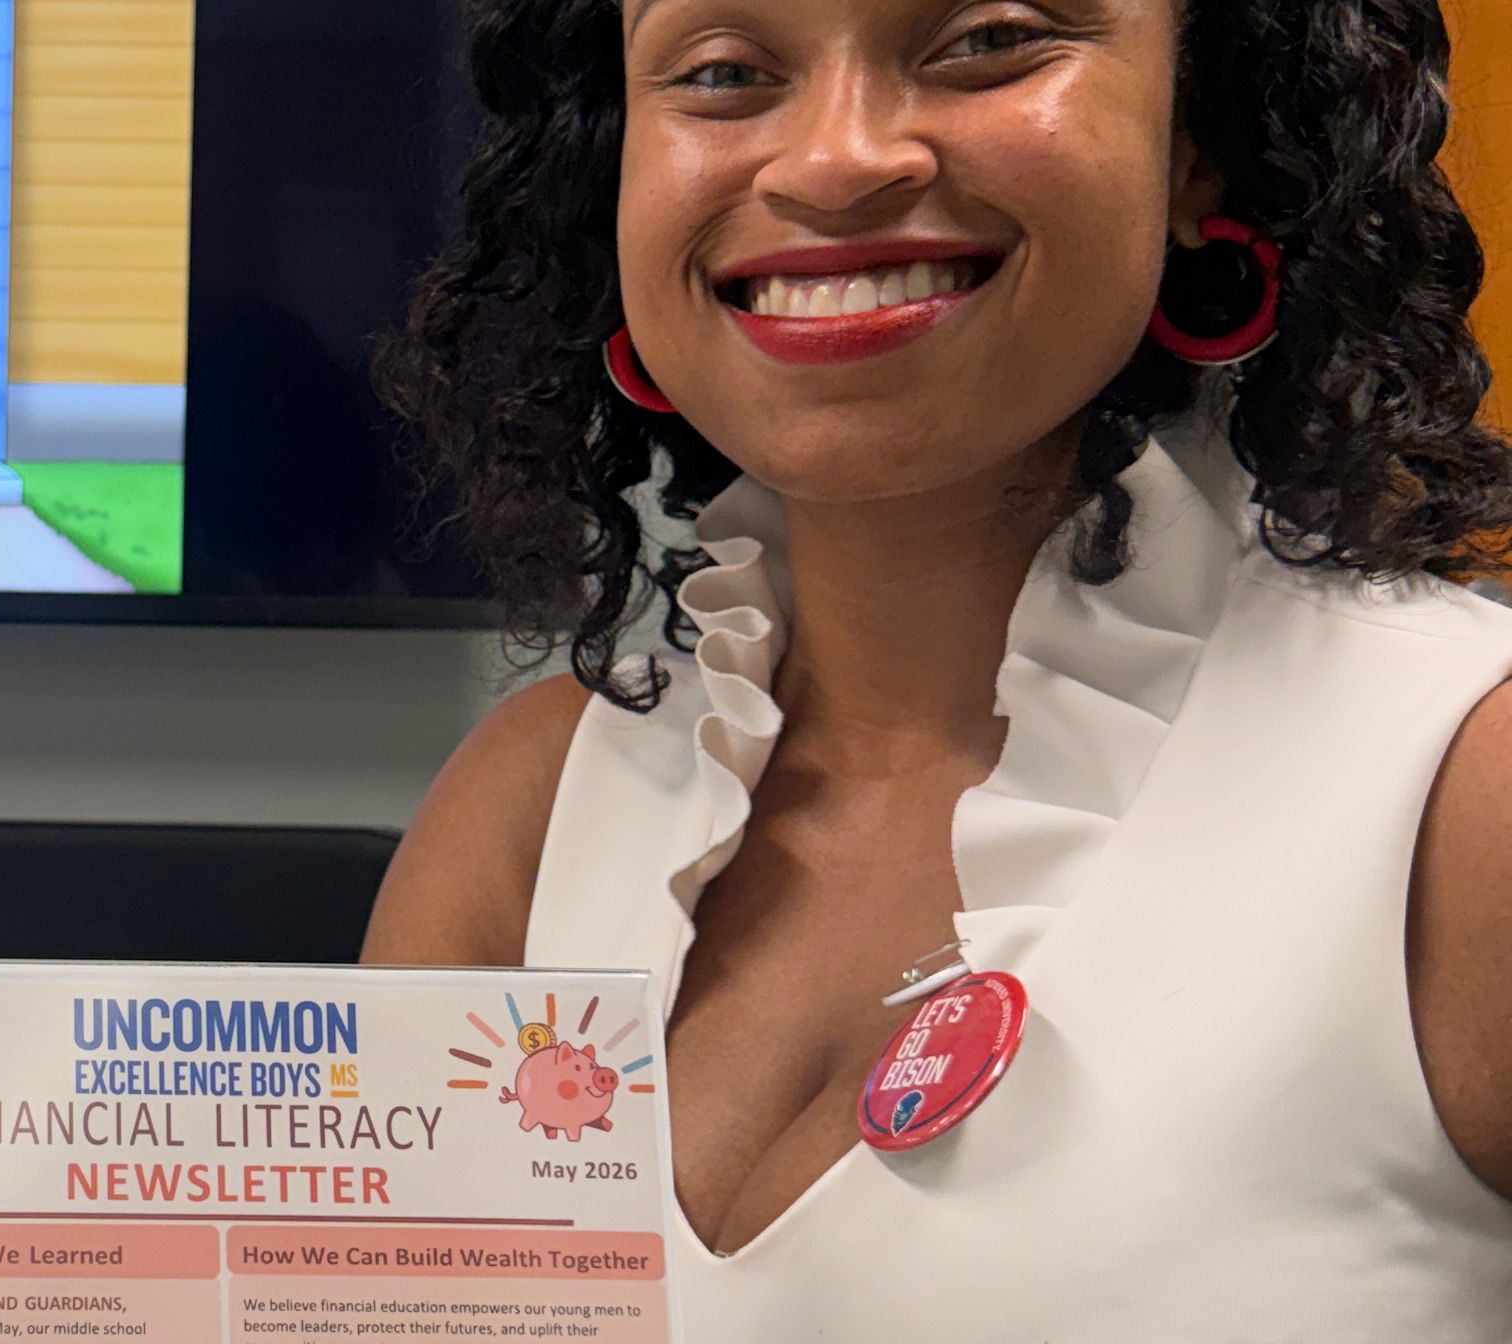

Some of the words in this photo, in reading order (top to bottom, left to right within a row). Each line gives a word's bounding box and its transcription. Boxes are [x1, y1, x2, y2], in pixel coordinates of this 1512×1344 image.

[73, 997, 358, 1054] UNCOMMON
[910, 994, 973, 1029] LET'S
[895, 1028, 931, 1060] GO
[75, 1059, 243, 1096] EXCELLENCE
[251, 1061, 321, 1098] BOYS
[330, 1062, 359, 1088] MS
[879, 1053, 952, 1091] BISON
[215, 1103, 443, 1151] LITERACY
[67, 1162, 391, 1205] NEWSLETTER
[531, 1161, 578, 1183] May
[584, 1162, 638, 1180] 2026
[29, 1244, 123, 1265] Learned
[242, 1245, 294, 1266] How
[301, 1246, 340, 1266] We
[345, 1246, 389, 1266] Can
[395, 1246, 453, 1267] Build
[460, 1247, 543, 1269] Wealth
[548, 1249, 649, 1274] Together
[25, 1296, 126, 1313] GUARDIANS,
[244, 1299, 265, 1311] We
[270, 1298, 317, 1312] believe
[321, 1298, 376, 1312] financial
[380, 1300, 446, 1313] education
[451, 1304, 520, 1316] empowers
[524, 1305, 546, 1314] our
[550, 1306, 591, 1318] young
[595, 1306, 624, 1316] men
[627, 1305, 640, 1316] to
[27, 1325, 50, 1334] our
[54, 1322, 100, 1334] middle
[104, 1322, 146, 1335] school
